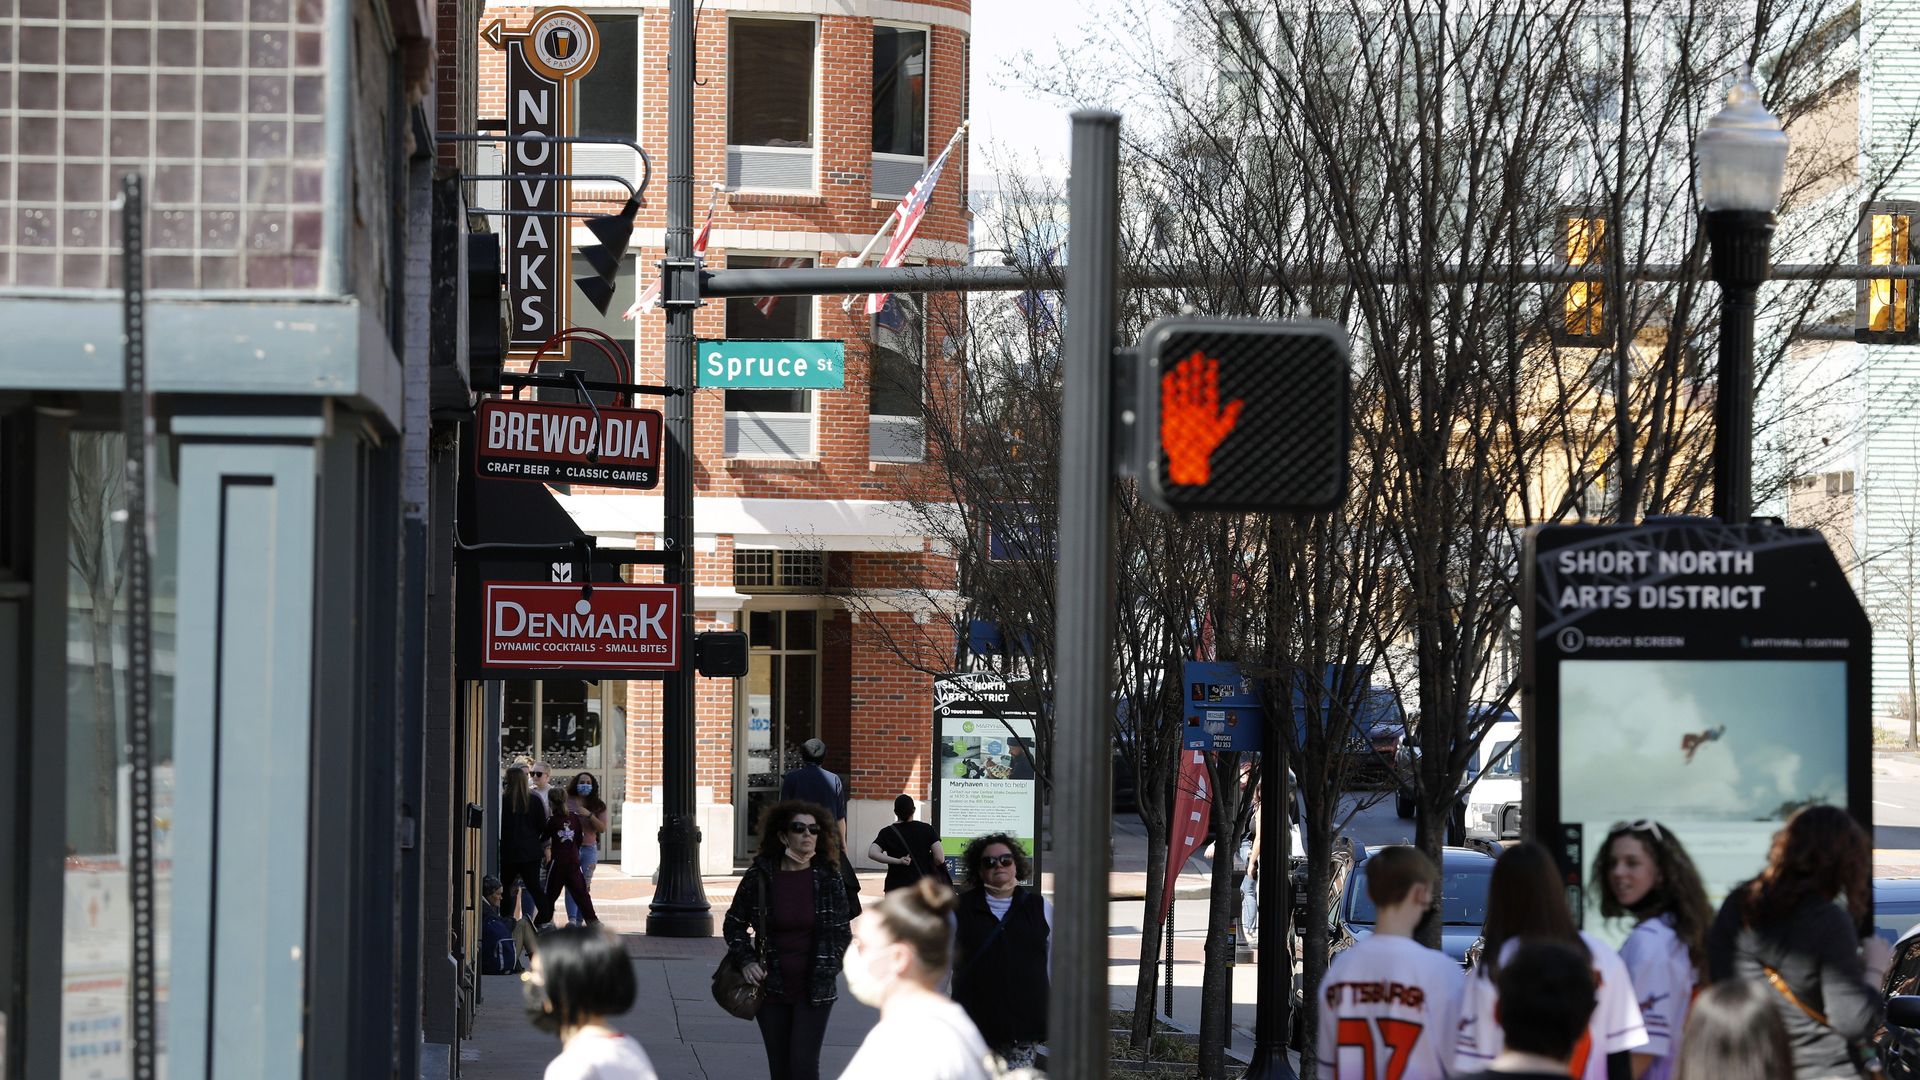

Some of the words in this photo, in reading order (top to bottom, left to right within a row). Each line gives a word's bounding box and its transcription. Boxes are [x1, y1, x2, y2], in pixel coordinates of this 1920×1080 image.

[544, 20, 577, 30] TAVERN
[553, 58, 576, 68] PATIO
[516, 89, 549, 332] NOVAKS
[707, 352, 808, 380] Spruce
[816, 358, 833, 372] St
[488, 410, 650, 460] BREWCADIA
[487, 462, 520, 474] CRAFT
[524, 464, 550, 475] BEER
[566, 467, 610, 480] CLASSIC
[612, 470, 648, 482] GAMES
[1558, 550, 1651, 574] SHORT
[1658, 551, 1754, 574] NORTH
[1558, 586, 1632, 609] ARTS
[1638, 586, 1766, 610] DISTRICT
[495, 600, 668, 640] DENMARK
[494, 642, 541, 652] DYNAMIC
[542, 642, 596, 652] COCKTAILS
[606, 644, 638, 653] SMALL
[640, 644, 668, 653] BITES
[1586, 636, 1632, 648] TOUCH
[1635, 636, 1685, 648] SCREEN
[942, 682, 972, 690] SHT
[974, 682, 1006, 690] NORTH
[942, 692, 966, 701] ARTS
